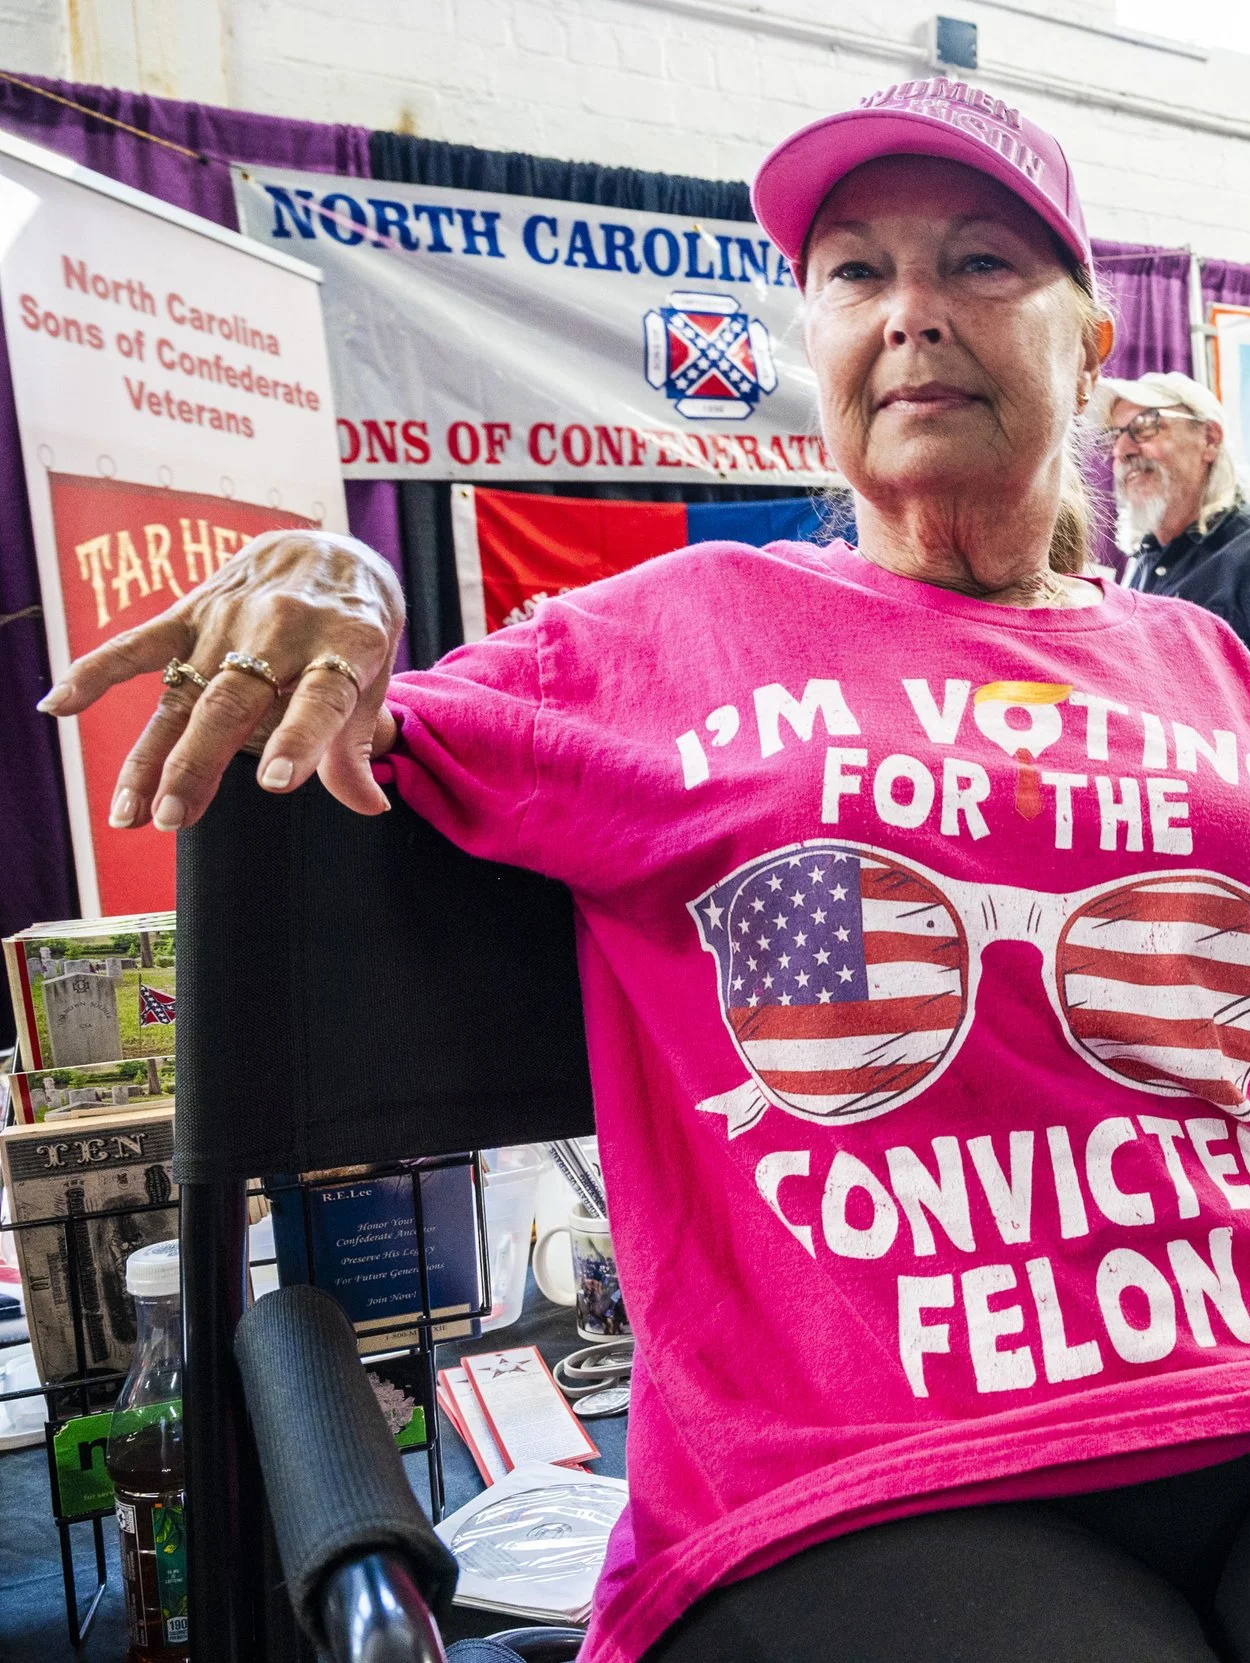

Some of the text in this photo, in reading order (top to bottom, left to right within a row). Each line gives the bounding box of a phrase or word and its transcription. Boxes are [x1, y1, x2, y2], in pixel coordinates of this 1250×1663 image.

[265, 187, 505, 258] NORTH
[62, 254, 282, 356] North Carolina
[19, 294, 321, 412] Sons of Confederate
[123, 376, 256, 439] Veterans
[446, 420, 512, 466] OF
[75, 523, 186, 630] TAR
[820, 746, 1193, 856] FOR THE
[36, 1133, 146, 1169] TEN
[321, 1189, 373, 1203] R.E.Lee
[336, 1225, 437, 1248] Confederate Ancetor
[356, 1217, 415, 1233] Honor Your
[340, 1246, 436, 1266] Preserve His Legcy
[389, 1262, 446, 1279] Generions
[366, 1297, 388, 1308] Join
[169, 1618, 187, 1631] 190
